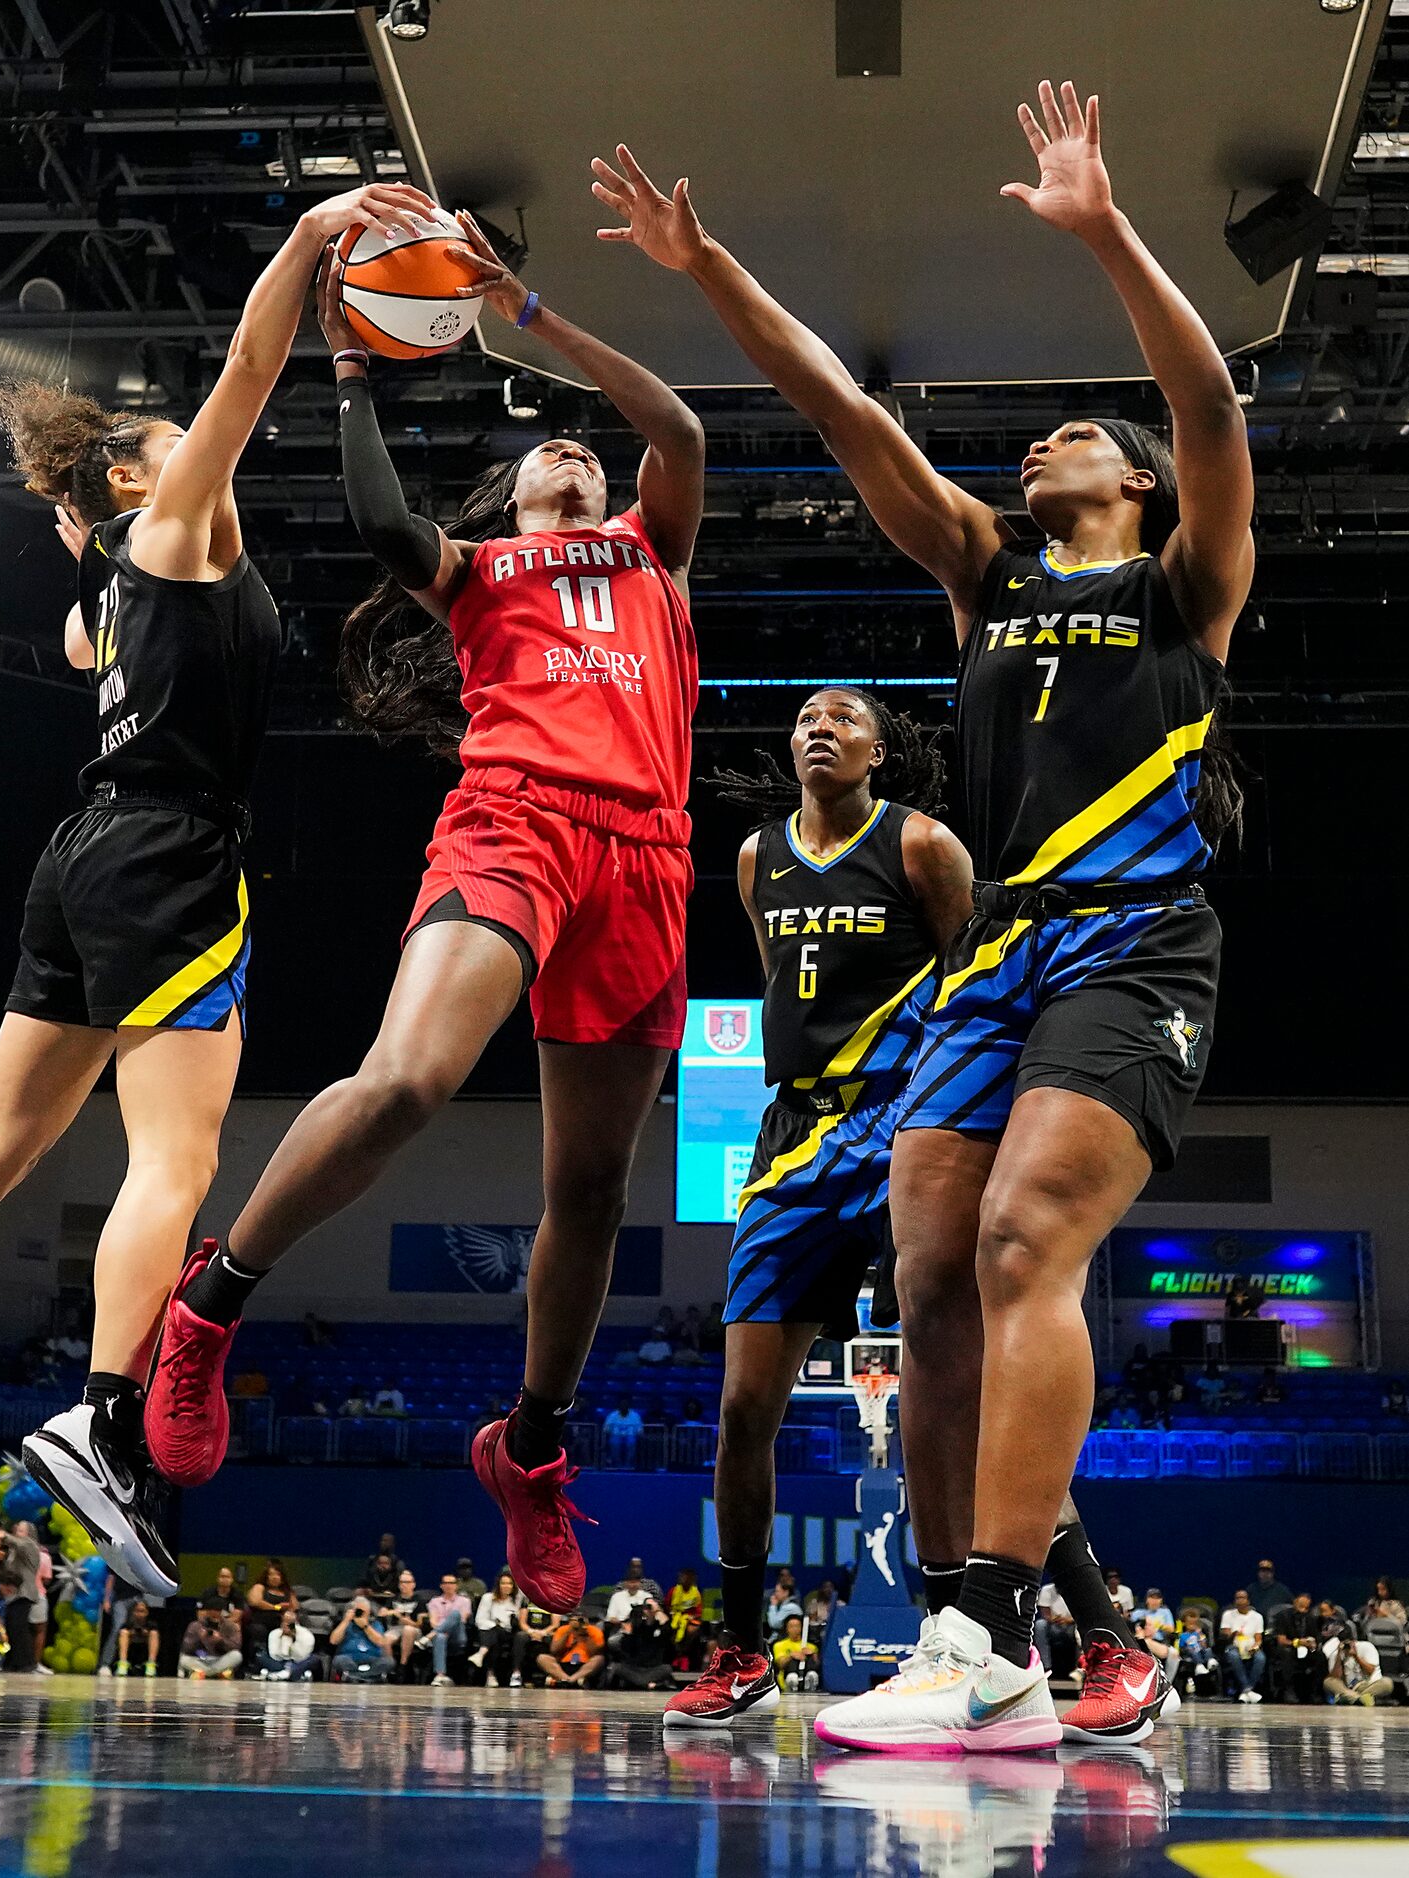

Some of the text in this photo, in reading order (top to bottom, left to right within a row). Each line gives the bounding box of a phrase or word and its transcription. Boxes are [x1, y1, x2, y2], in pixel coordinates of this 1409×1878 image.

[494, 540, 657, 583] ATLANTA
[96, 572, 120, 674] 12
[551, 575, 616, 634] 10
[985, 613, 1140, 652] TEXAS
[543, 642, 647, 680] EMORY
[98, 665, 126, 717] URTON
[1032, 656, 1060, 724] 7
[109, 712, 140, 752] AT&T
[764, 905, 887, 939] TEXAS
[798, 943, 820, 1000] 6
[1150, 1271, 1236, 1294] FLIGHT
